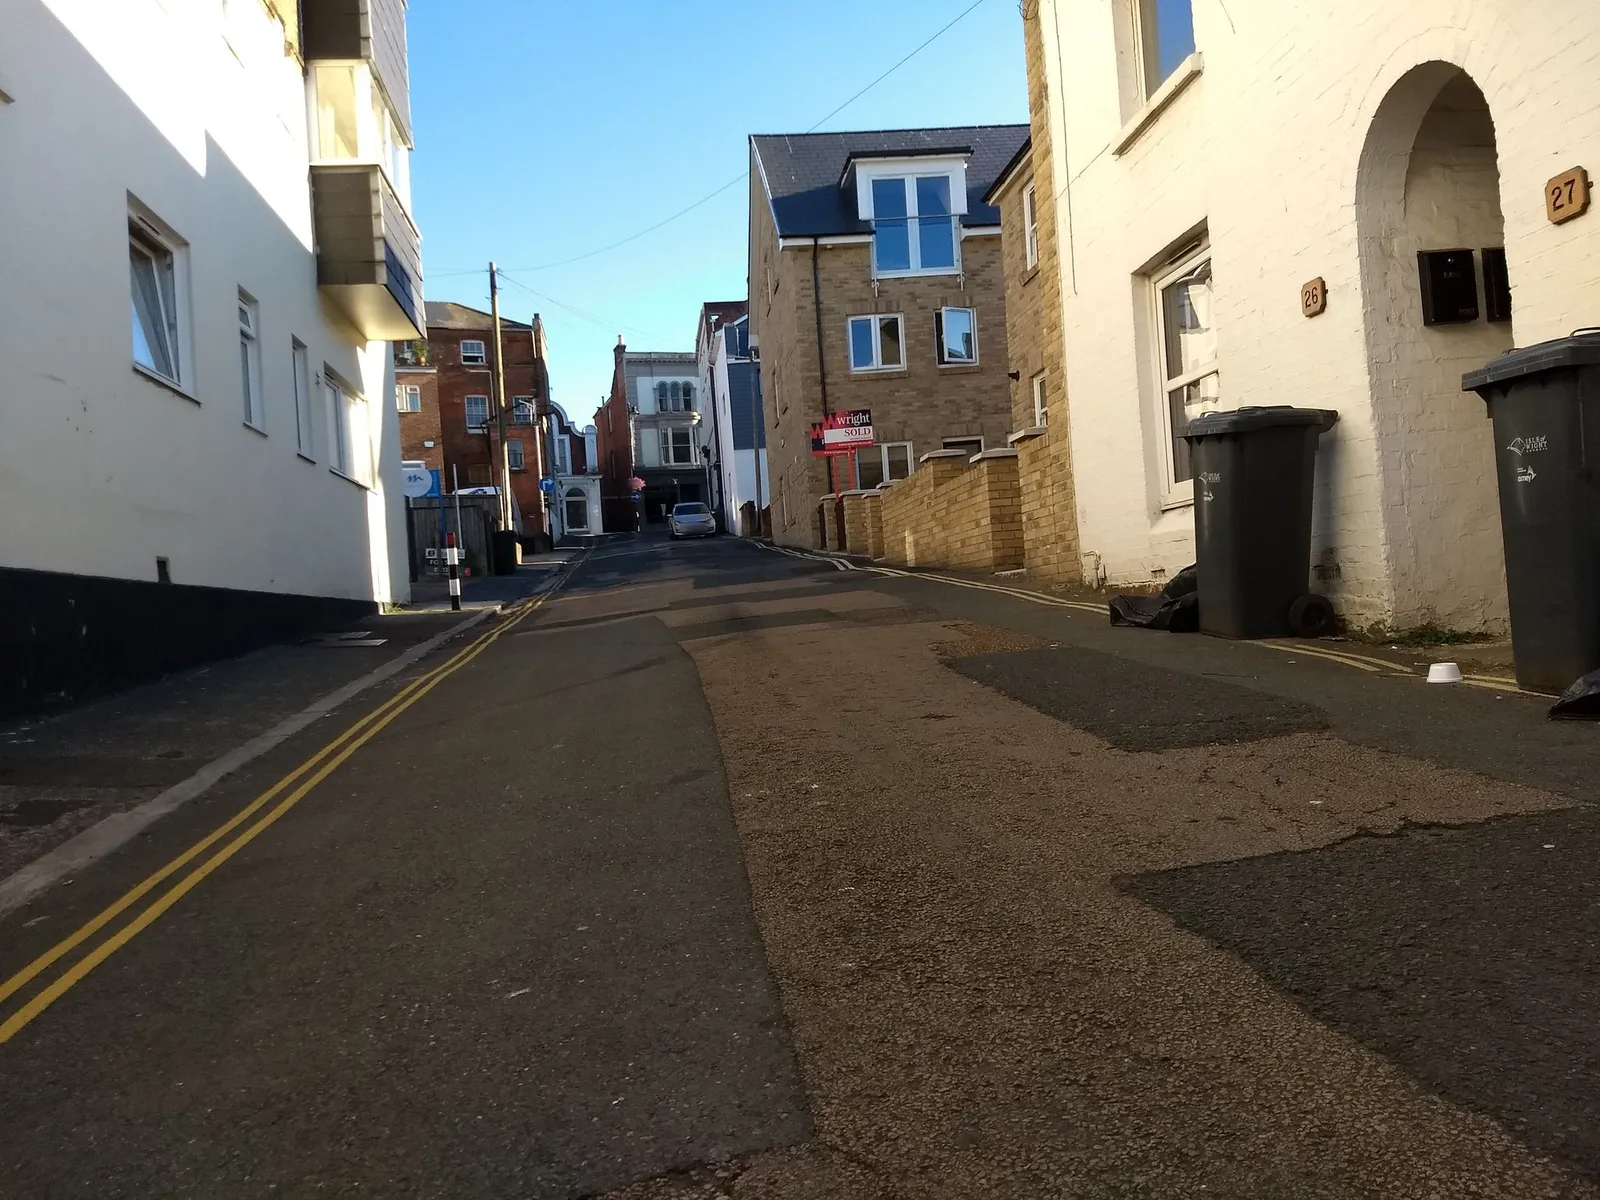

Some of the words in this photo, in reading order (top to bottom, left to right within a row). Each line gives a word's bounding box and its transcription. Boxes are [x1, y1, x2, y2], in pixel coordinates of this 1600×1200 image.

[1551, 178, 1576, 212] 27
[1304, 286, 1319, 309] 26
[836, 412, 871, 427] wright
[844, 427, 871, 437] SOLD
[1525, 436, 1540, 445] ISLE
[1525, 440, 1548, 450] WIGHT
